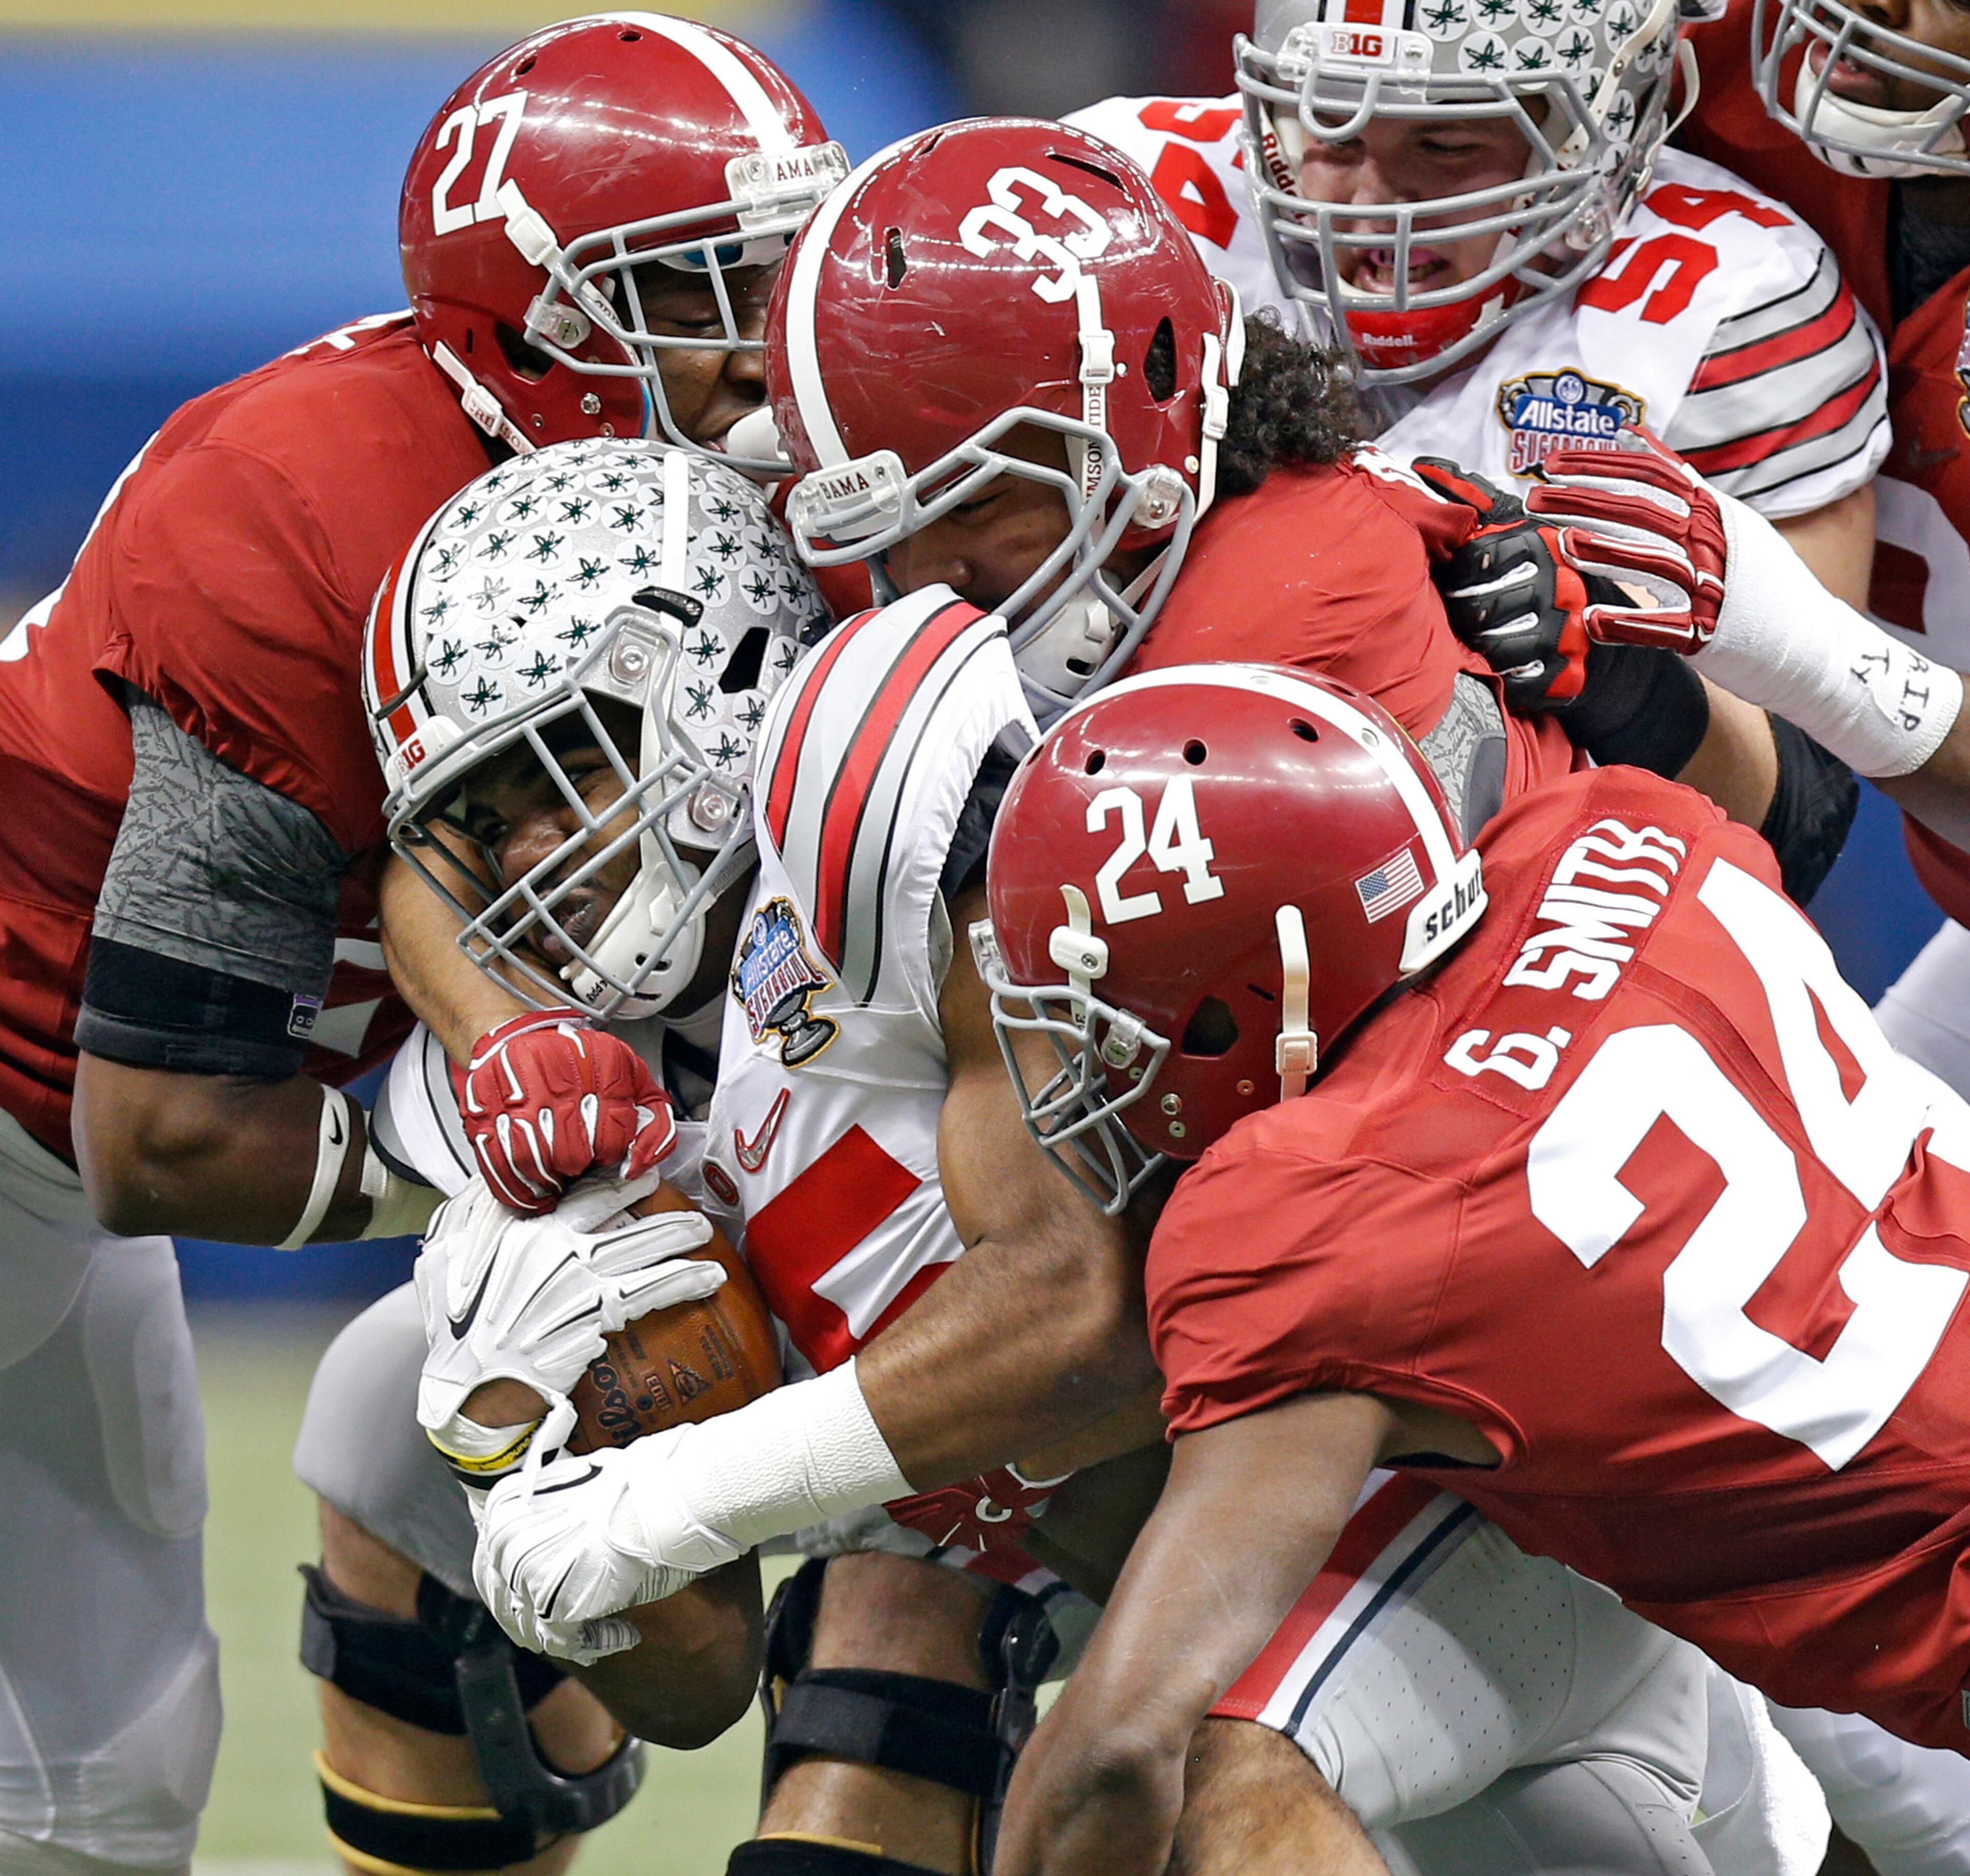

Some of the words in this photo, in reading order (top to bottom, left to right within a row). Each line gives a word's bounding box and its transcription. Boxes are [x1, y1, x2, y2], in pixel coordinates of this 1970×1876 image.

[432, 90, 528, 237] 27
[773, 158, 815, 181] AMA
[957, 165, 1112, 304] 33
[1570, 183, 1796, 325] 54
[1089, 386, 1101, 427] TIDE
[1516, 400, 1616, 436] Allstate
[819, 472, 870, 499] BAMA
[1085, 776, 1225, 924] 24
[1423, 868, 1481, 943] schut
[1501, 818, 1687, 1001] SMITH
[746, 930, 794, 992] Allstate
[1526, 855, 1970, 1472] 24
